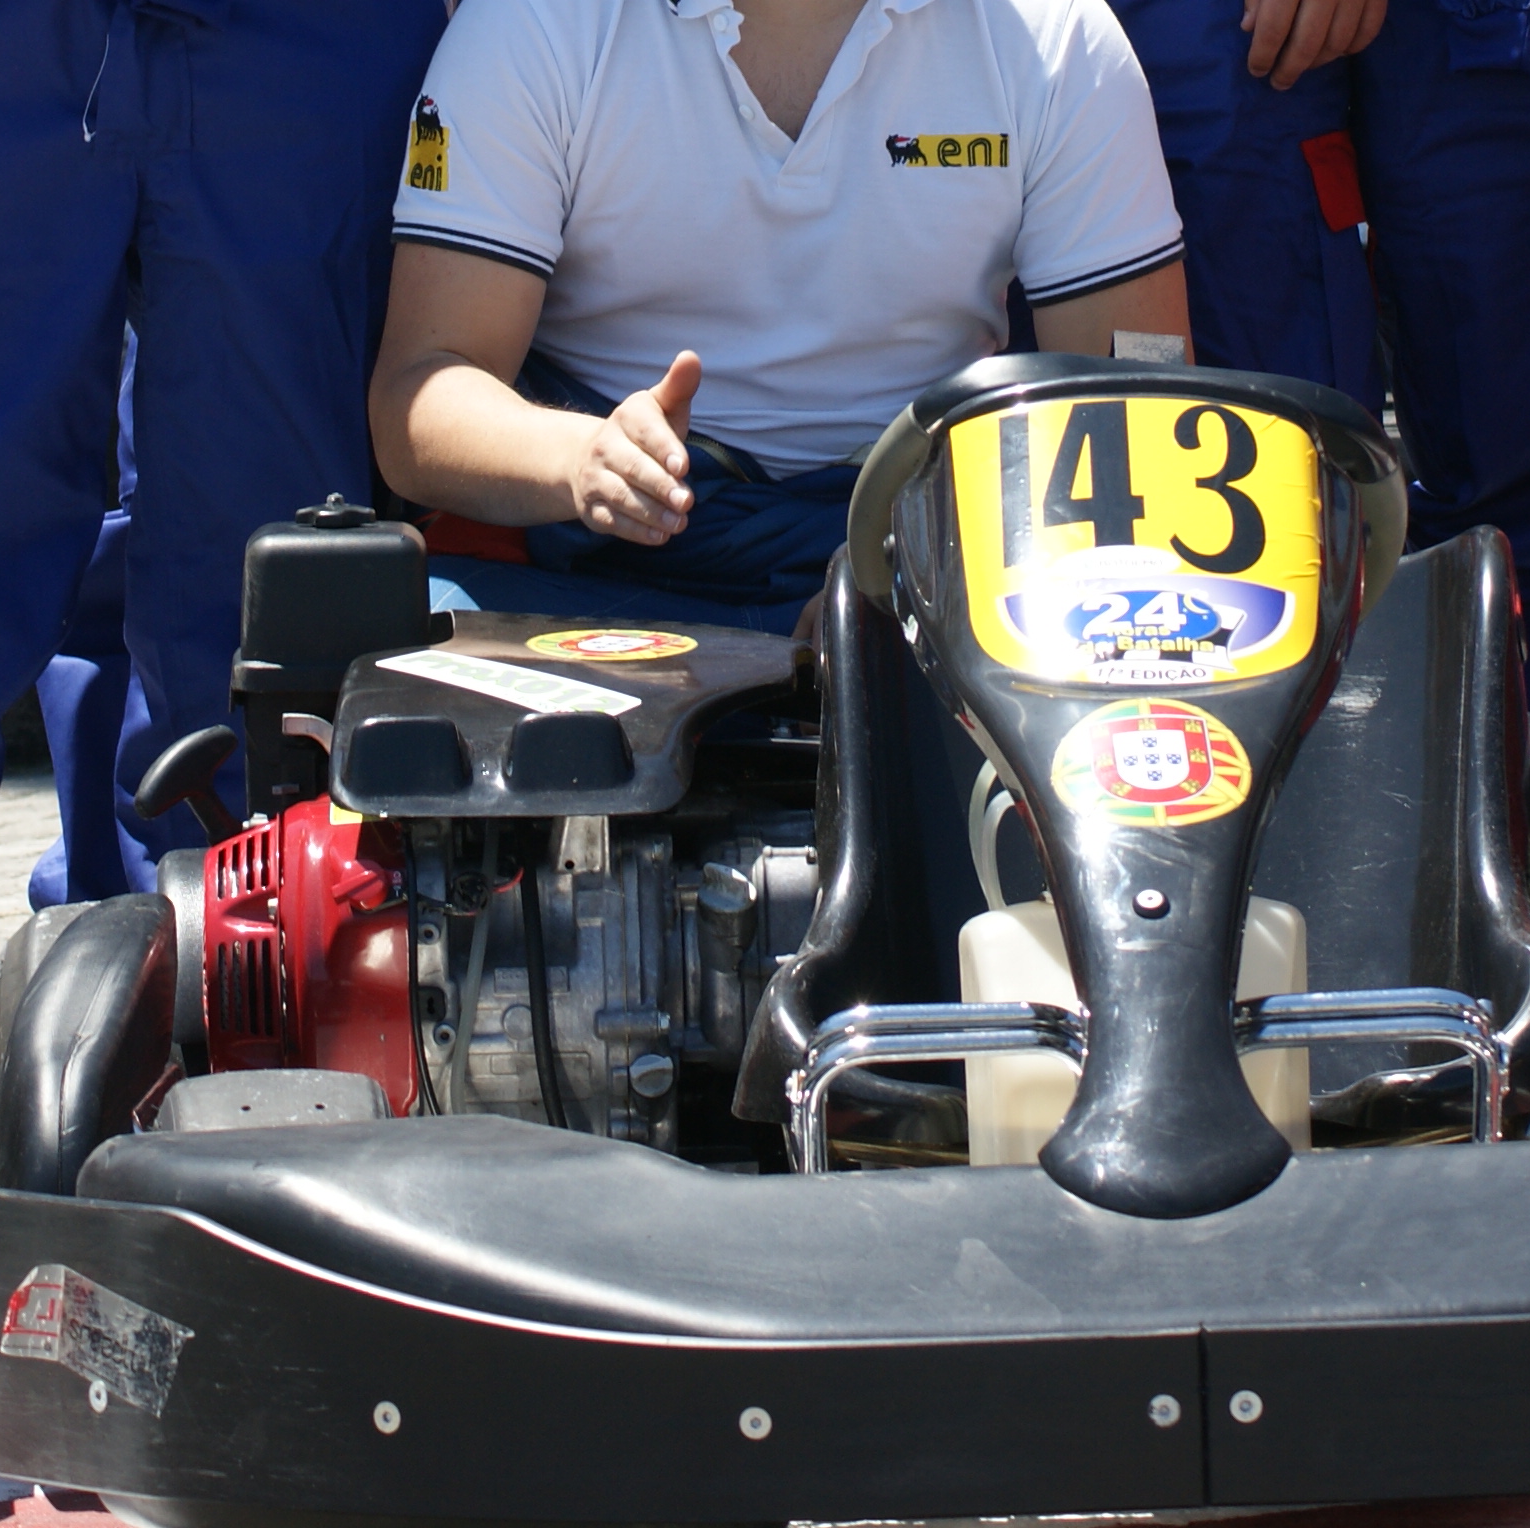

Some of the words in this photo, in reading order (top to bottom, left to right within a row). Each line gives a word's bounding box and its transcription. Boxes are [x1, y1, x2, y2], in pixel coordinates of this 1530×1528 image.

[936, 133, 1009, 168] eni
[410, 153, 443, 192] eni
[998, 399, 1267, 575] 143
[1081, 590, 1188, 640] 24
[1116, 635, 1215, 653] Batalha
[1130, 664, 1207, 682] EDIÇÃO
